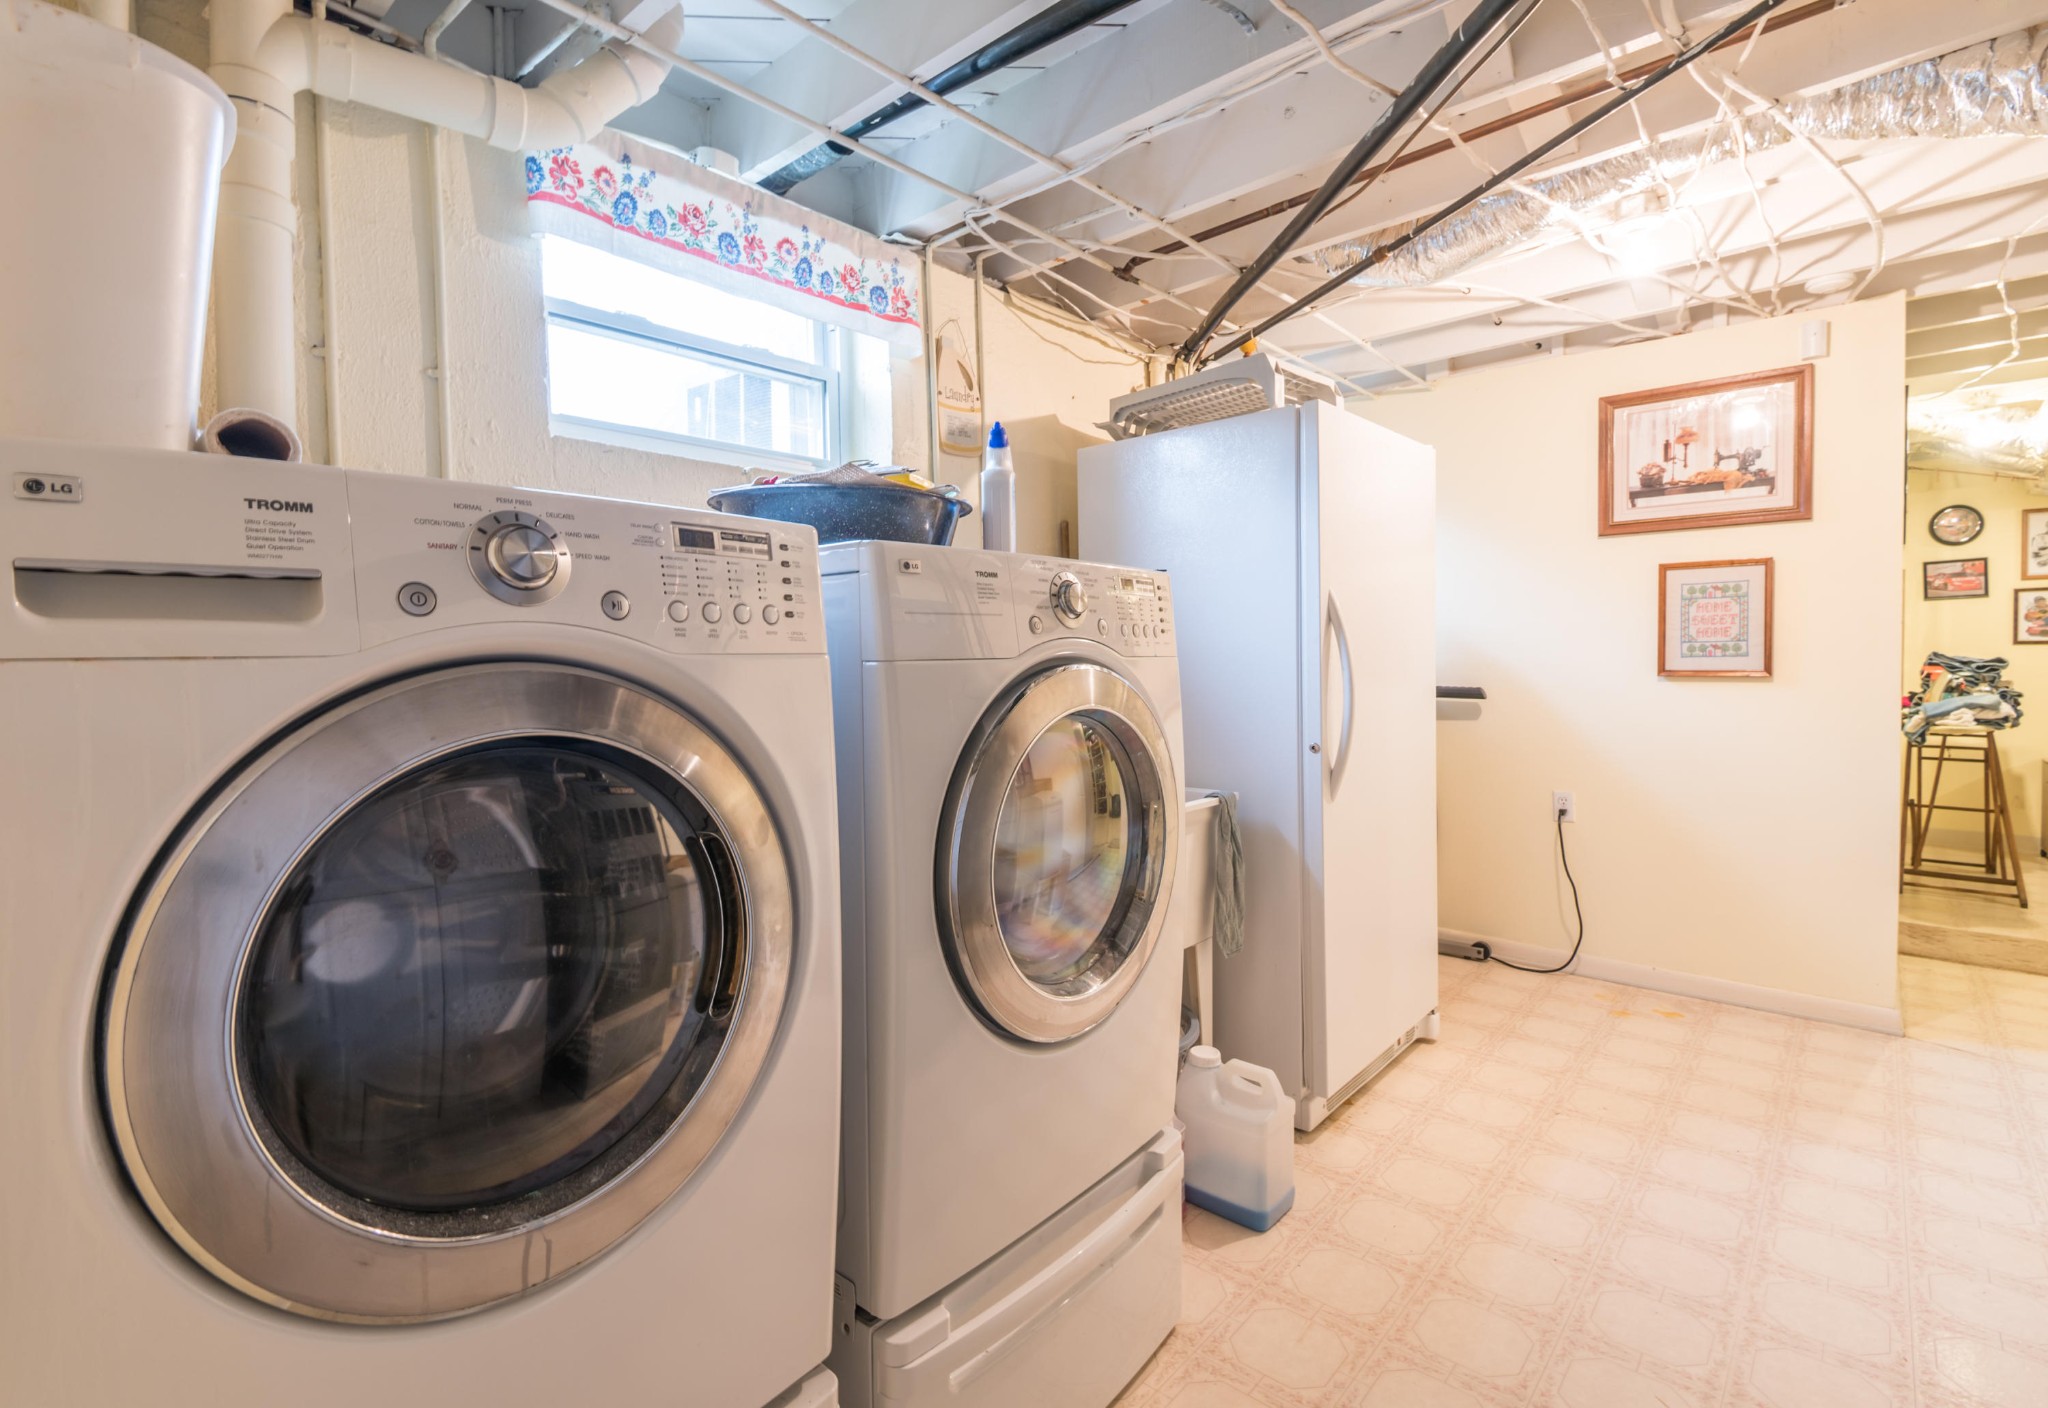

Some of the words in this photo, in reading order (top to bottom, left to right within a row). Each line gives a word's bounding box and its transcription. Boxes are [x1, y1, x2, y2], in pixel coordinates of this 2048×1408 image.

[944, 385, 975, 412] Laundry
[51, 482, 73, 494] LG
[243, 498, 313, 513] TROMM
[496, 497, 514, 505] PERM
[453, 502, 482, 511] NORMAL
[545, 511, 575, 520] DELICATES
[262, 519, 297, 528] Capacity
[414, 517, 466, 528] COTTON/TOWELS
[246, 542, 266, 550] Quiet
[267, 543, 304, 551] Operation
[427, 542, 458, 550] SANITARY
[975, 570, 999, 578] TROMM
[1695, 601, 1732, 613] HOME
[1691, 613, 1739, 626] SWEET
[1695, 626, 1732, 638] HOME
